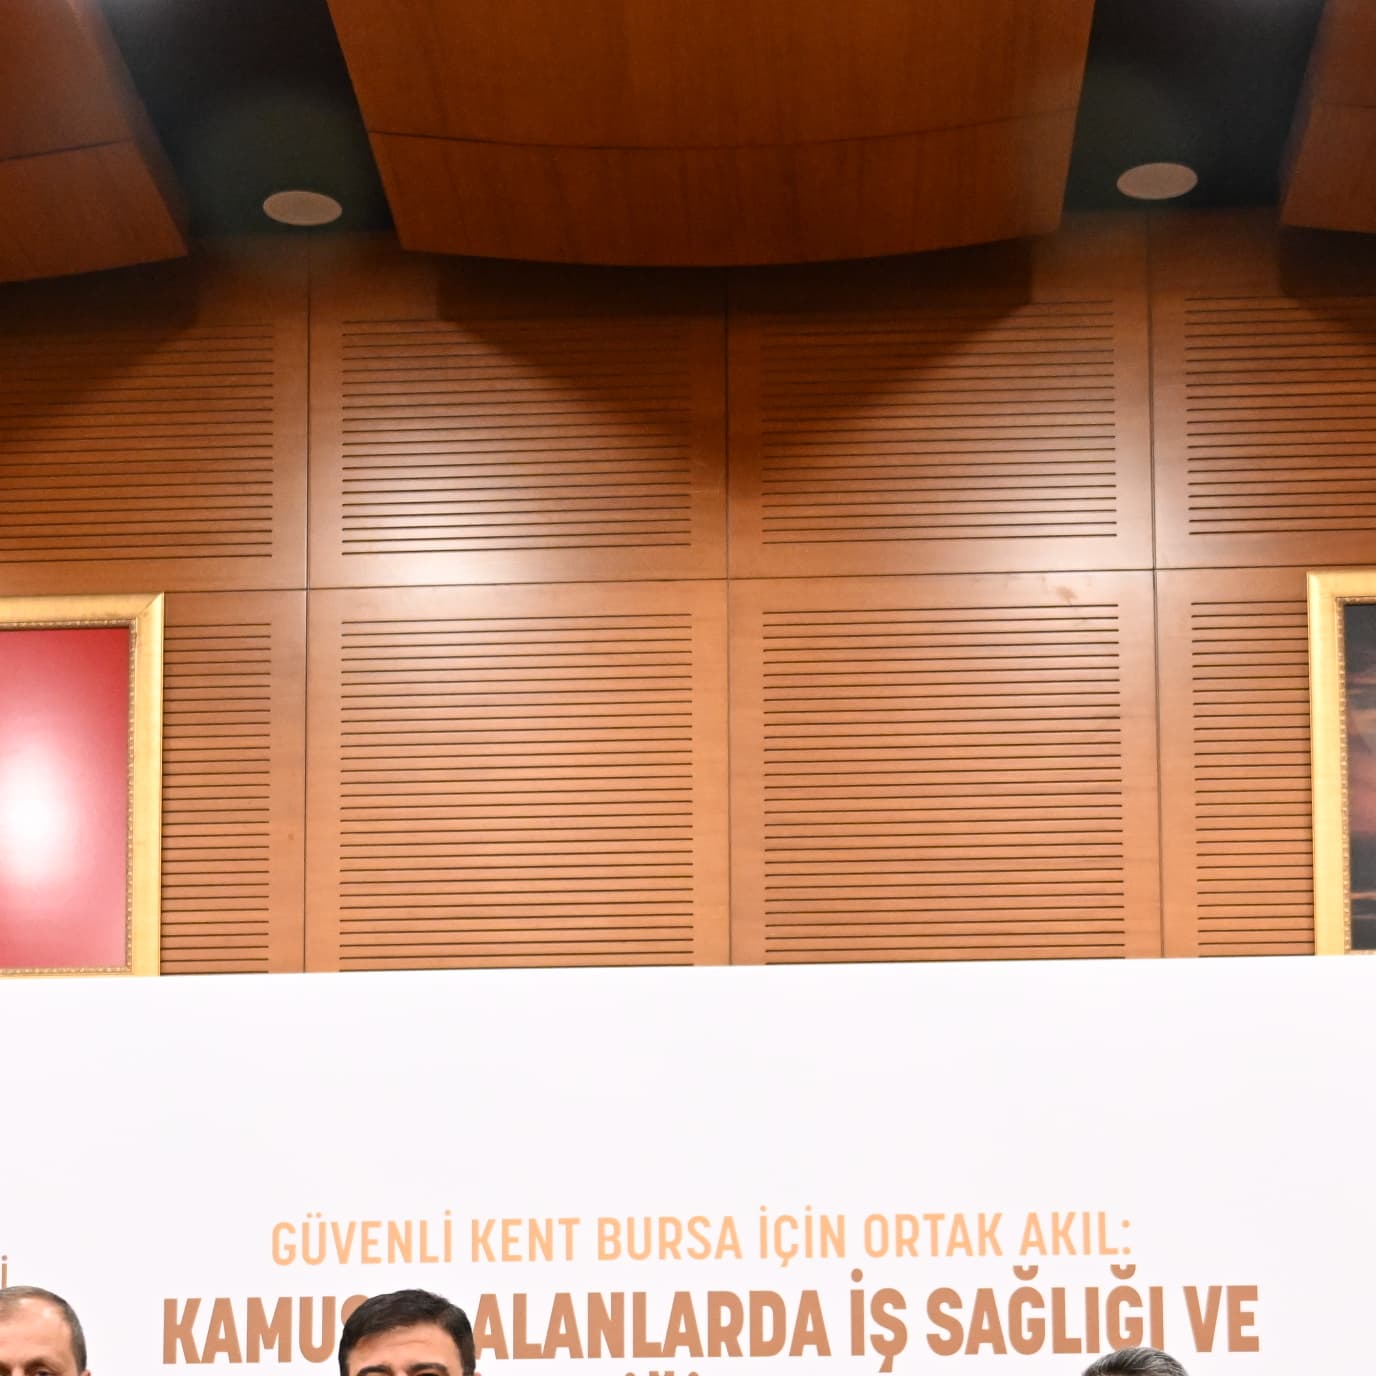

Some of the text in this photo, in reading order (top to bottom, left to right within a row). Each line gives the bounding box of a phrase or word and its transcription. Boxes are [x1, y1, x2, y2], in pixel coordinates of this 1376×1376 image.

[271, 1205, 1132, 1267] GÜVENLİ KENT BURSA İÇİN ORTAK AKIL:
[162, 1263, 1260, 1373] KAMU ALANLARDA İŞ SAĞLIĞI VE
